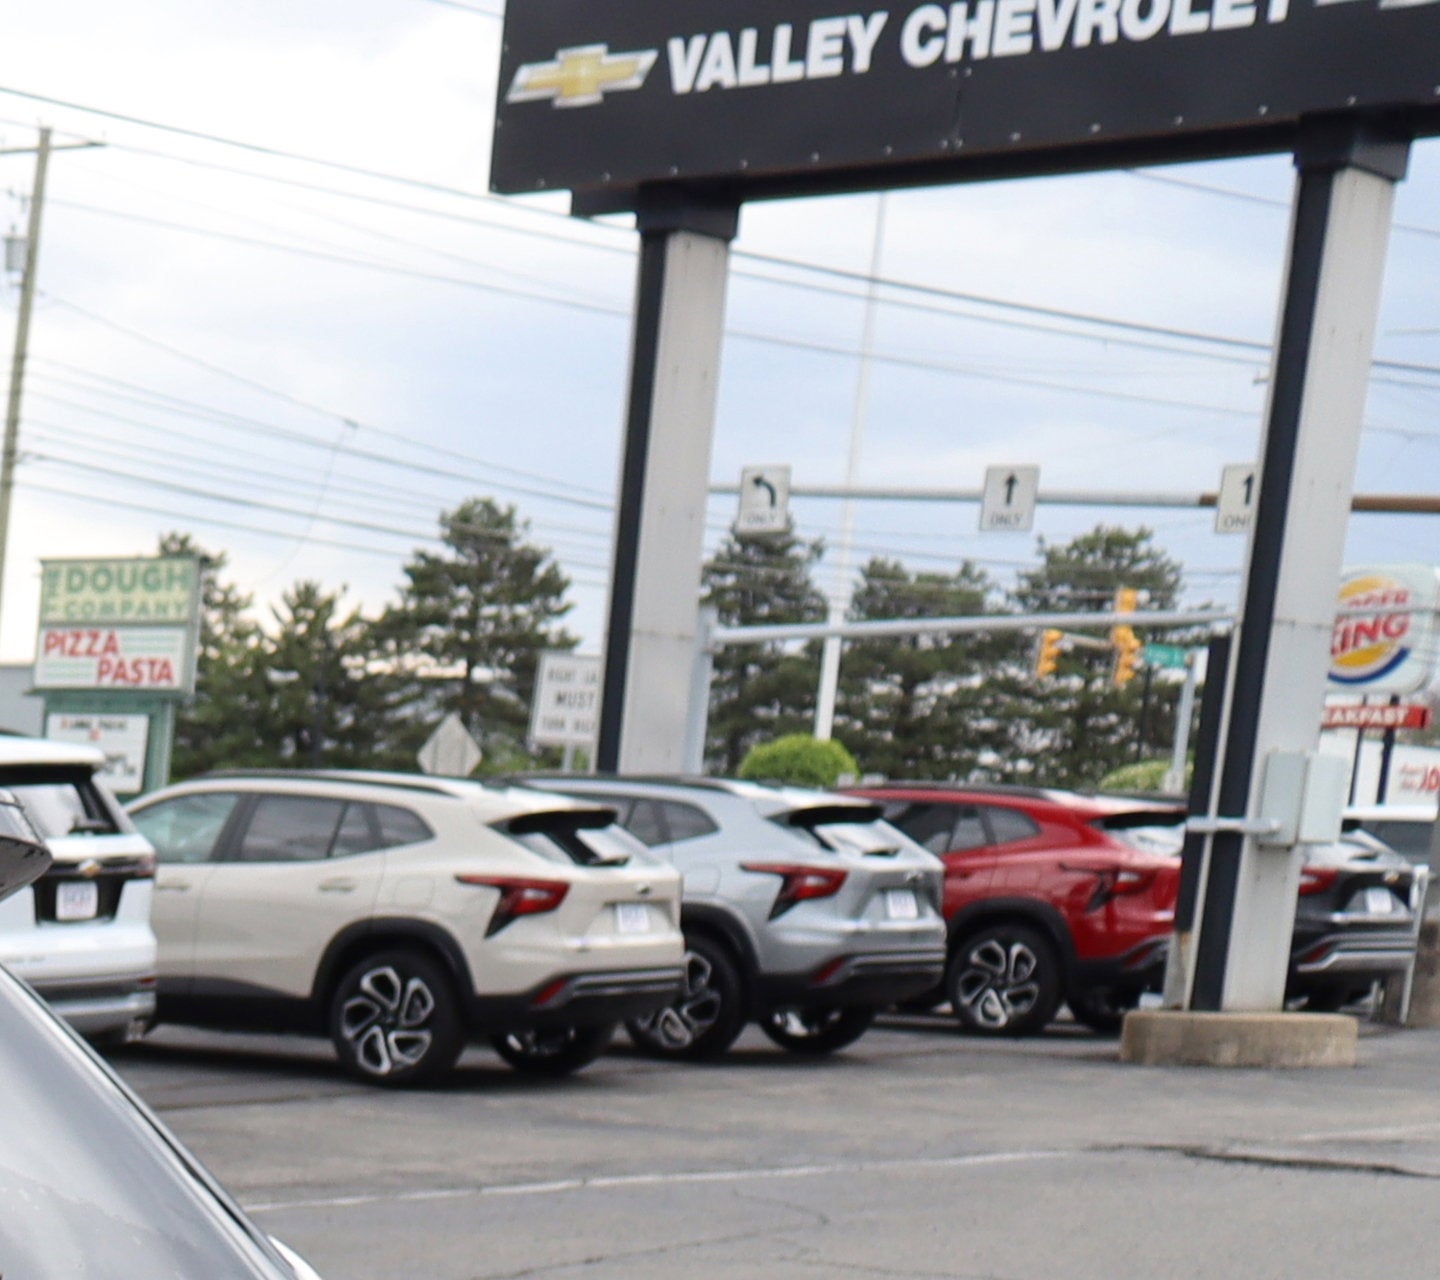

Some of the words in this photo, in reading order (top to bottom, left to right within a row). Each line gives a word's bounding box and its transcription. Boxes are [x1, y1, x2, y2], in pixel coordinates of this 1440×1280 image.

[667, 11, 888, 94] VALLEY
[65, 566, 193, 594] DOUGH
[64, 600, 187, 620] COMPANY
[44, 629, 118, 657] PIZZA
[95, 656, 174, 685] PASTA
